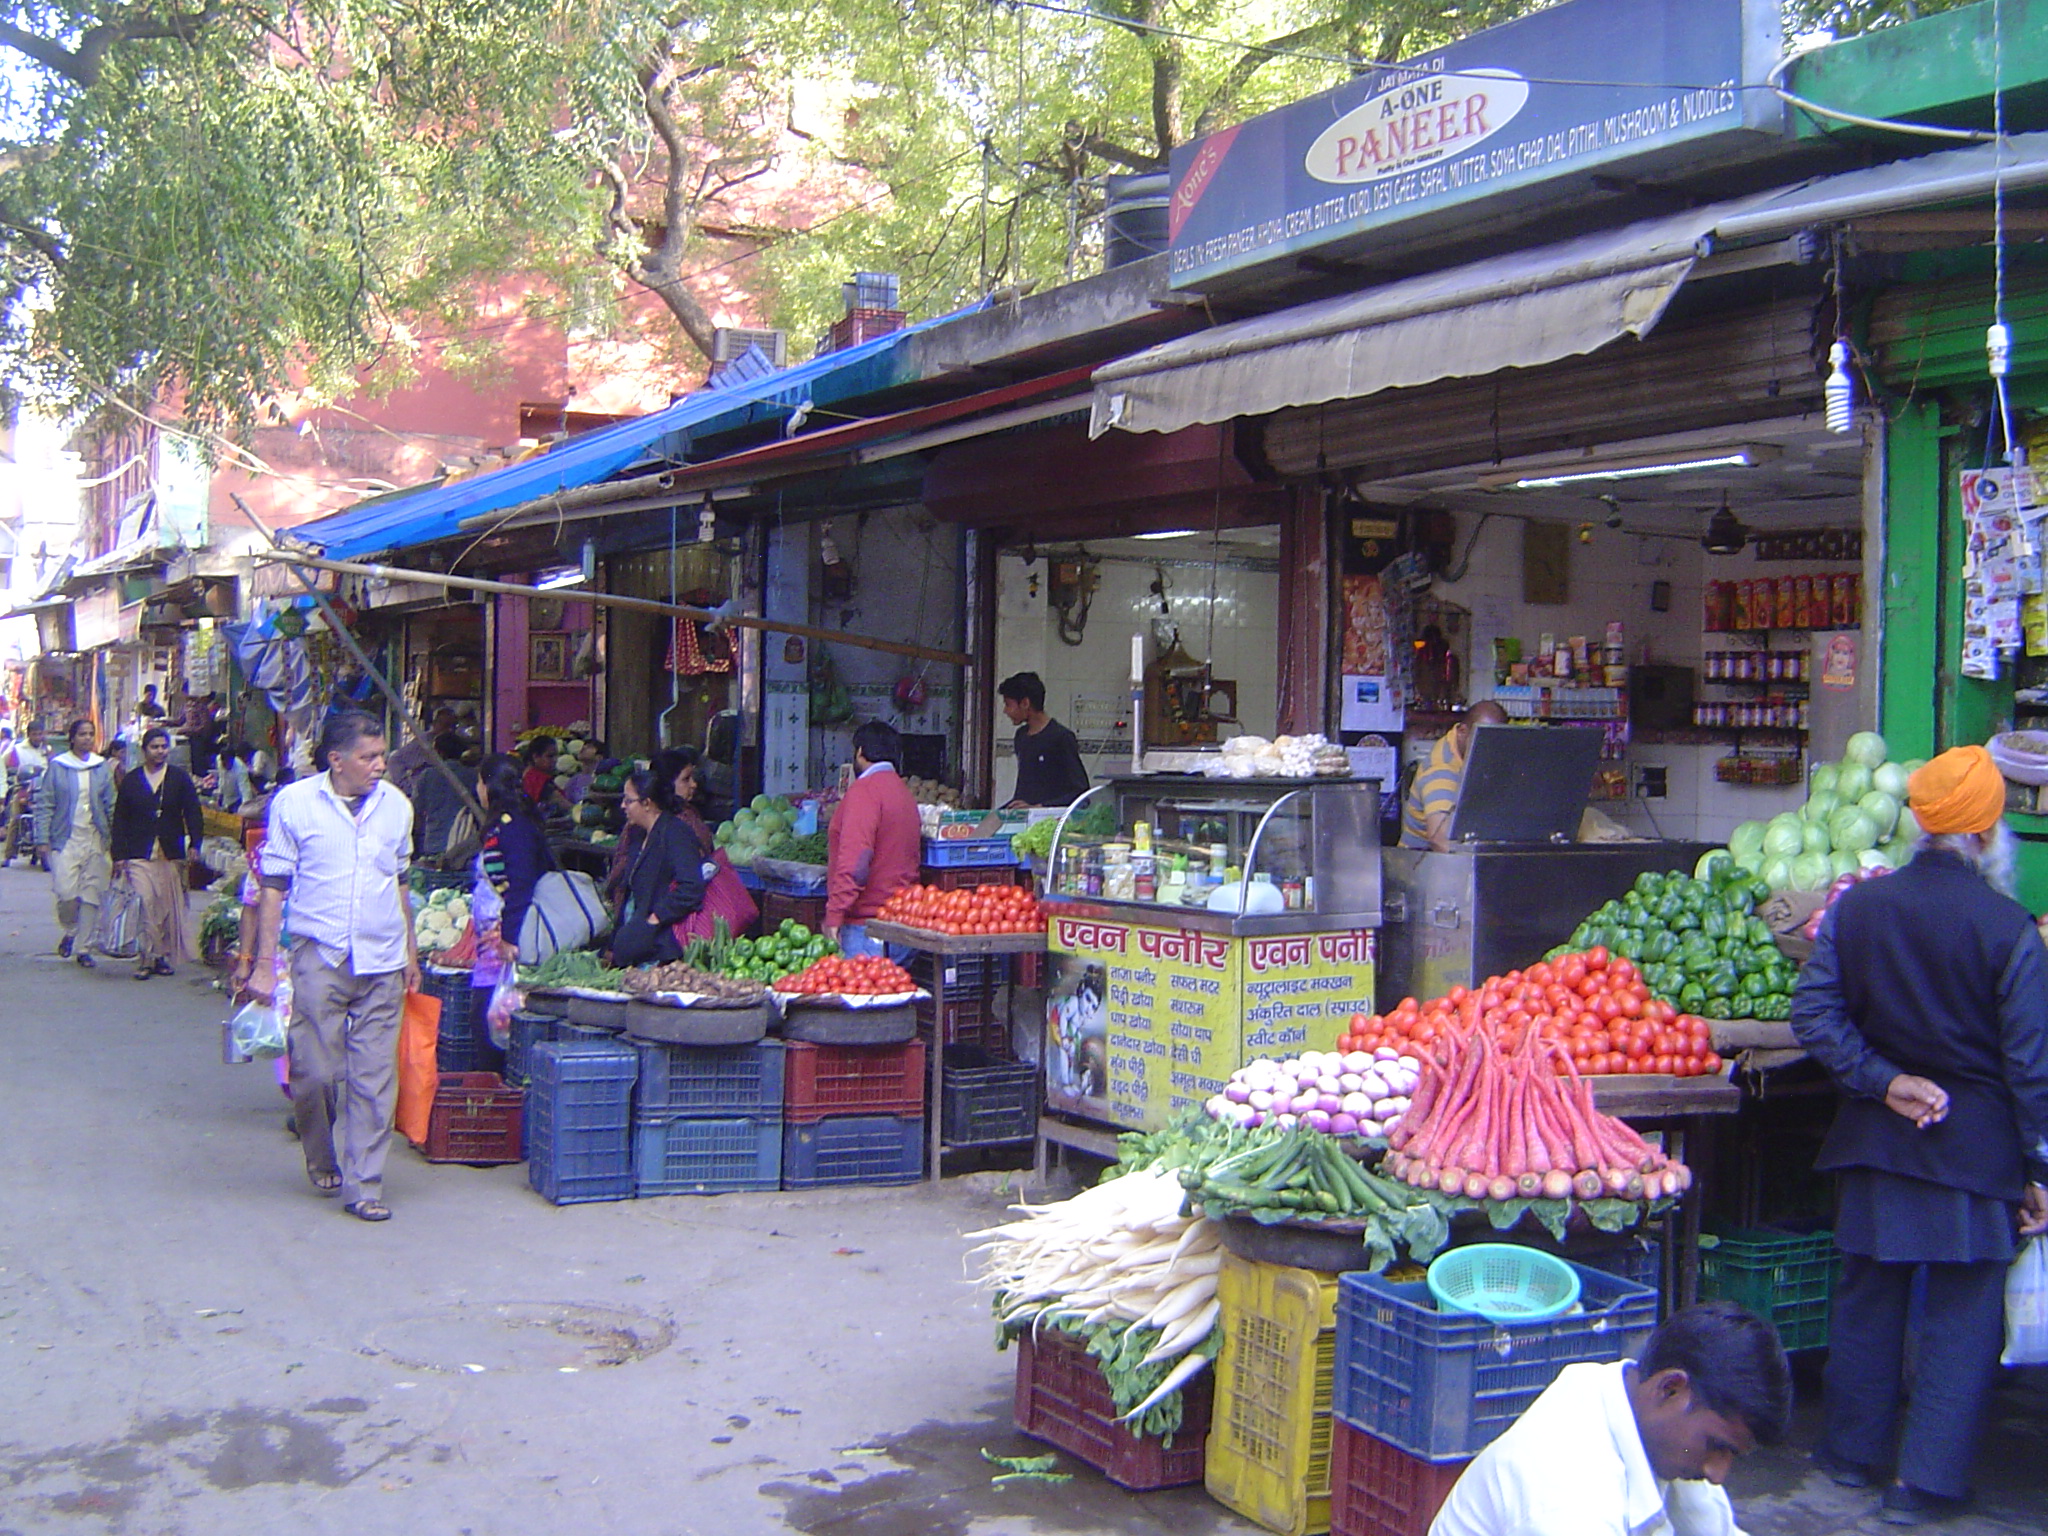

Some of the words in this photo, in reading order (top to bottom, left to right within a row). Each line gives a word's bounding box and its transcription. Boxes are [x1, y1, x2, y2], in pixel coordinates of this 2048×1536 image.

[1432, 56, 1445, 72] DI
[1380, 79, 1443, 120] A-ONE
[1336, 92, 1491, 177] PANEER
[1374, 180, 1392, 211] DESI
[1421, 164, 1447, 197] SAFAL
[1491, 144, 1515, 177] SOYA
[1547, 130, 1566, 163] DAL
[1605, 100, 1666, 147] MUSHROOM
[1670, 95, 1680, 128] &
[1057, 919, 1129, 953] एवन
[1138, 927, 1229, 969] पनीर
[1249, 937, 1312, 970] एवन
[1134, 967, 1156, 986] पनीर
[1131, 990, 1153, 1008] खोया
[1296, 1003, 1320, 1016] दाल
[1247, 1028, 1275, 1046] स्वीट
[1198, 1076, 1226, 1094] मक्ख
